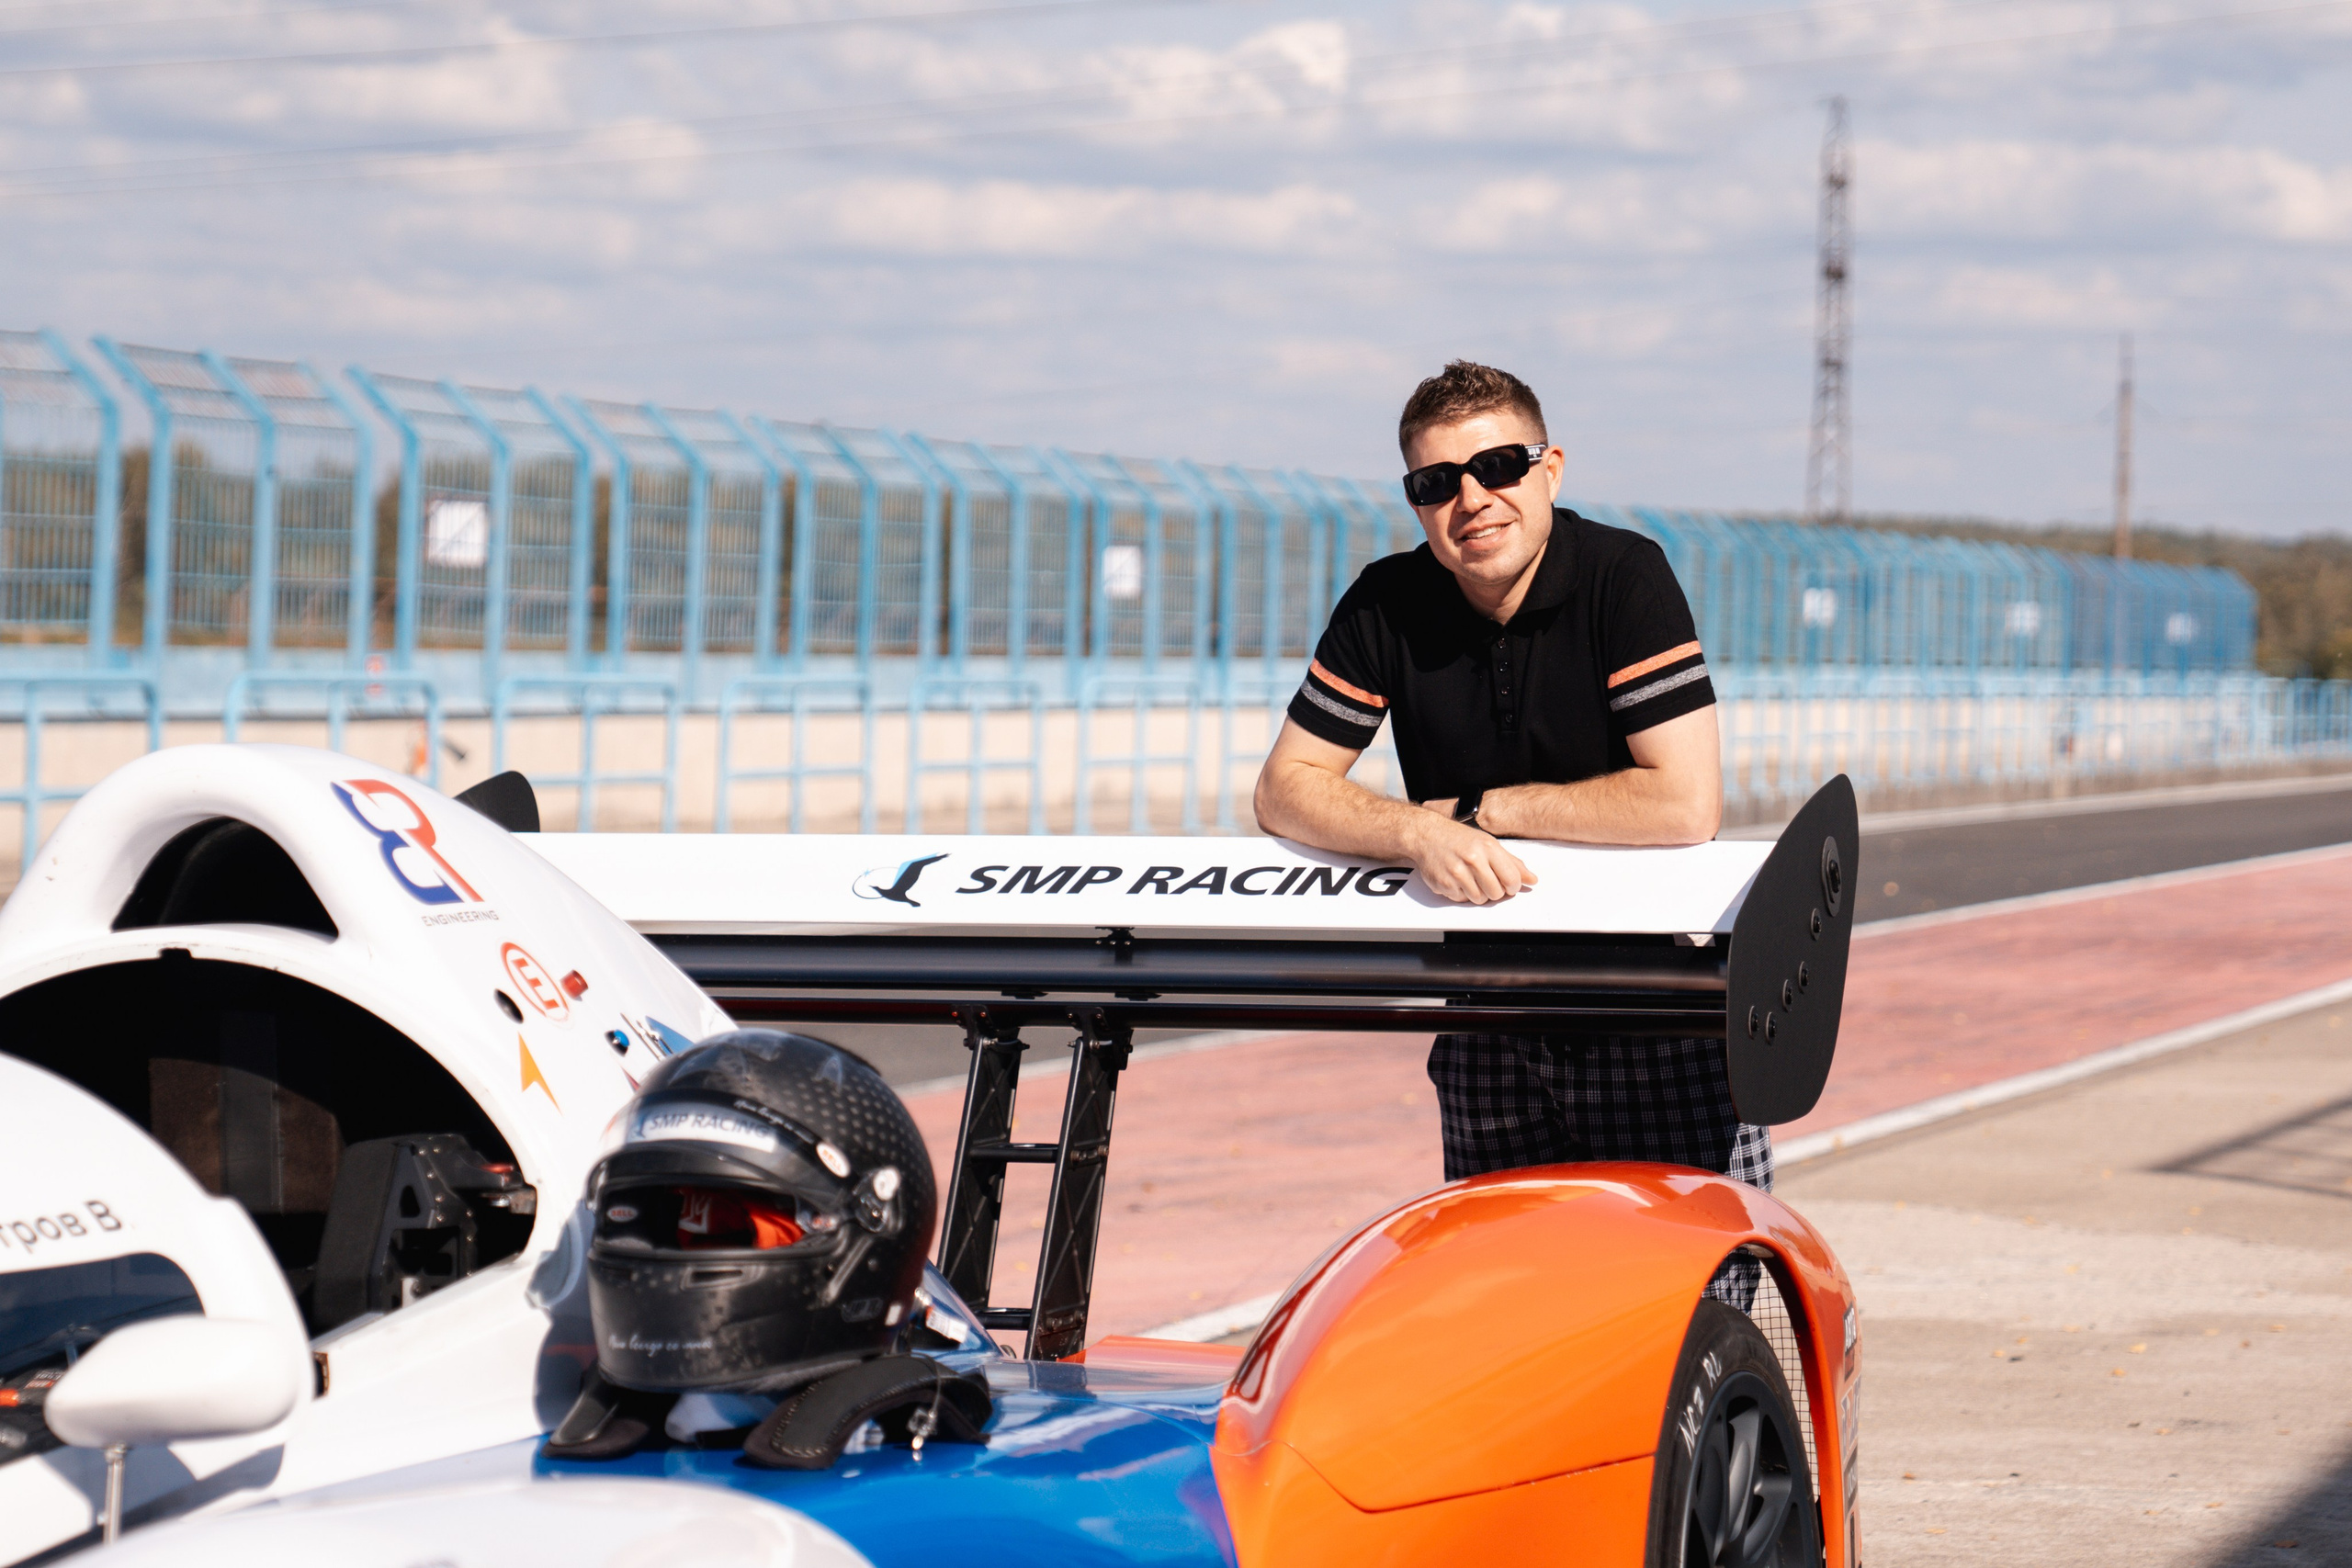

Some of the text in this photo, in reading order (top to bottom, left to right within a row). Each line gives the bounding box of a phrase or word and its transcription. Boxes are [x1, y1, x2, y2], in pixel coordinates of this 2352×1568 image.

[956, 865, 1415, 897] SMP RACING
[422, 909, 500, 927] ENGINEERING
[649, 1112, 687, 1131] SMP
[691, 1113, 771, 1139] RACING
